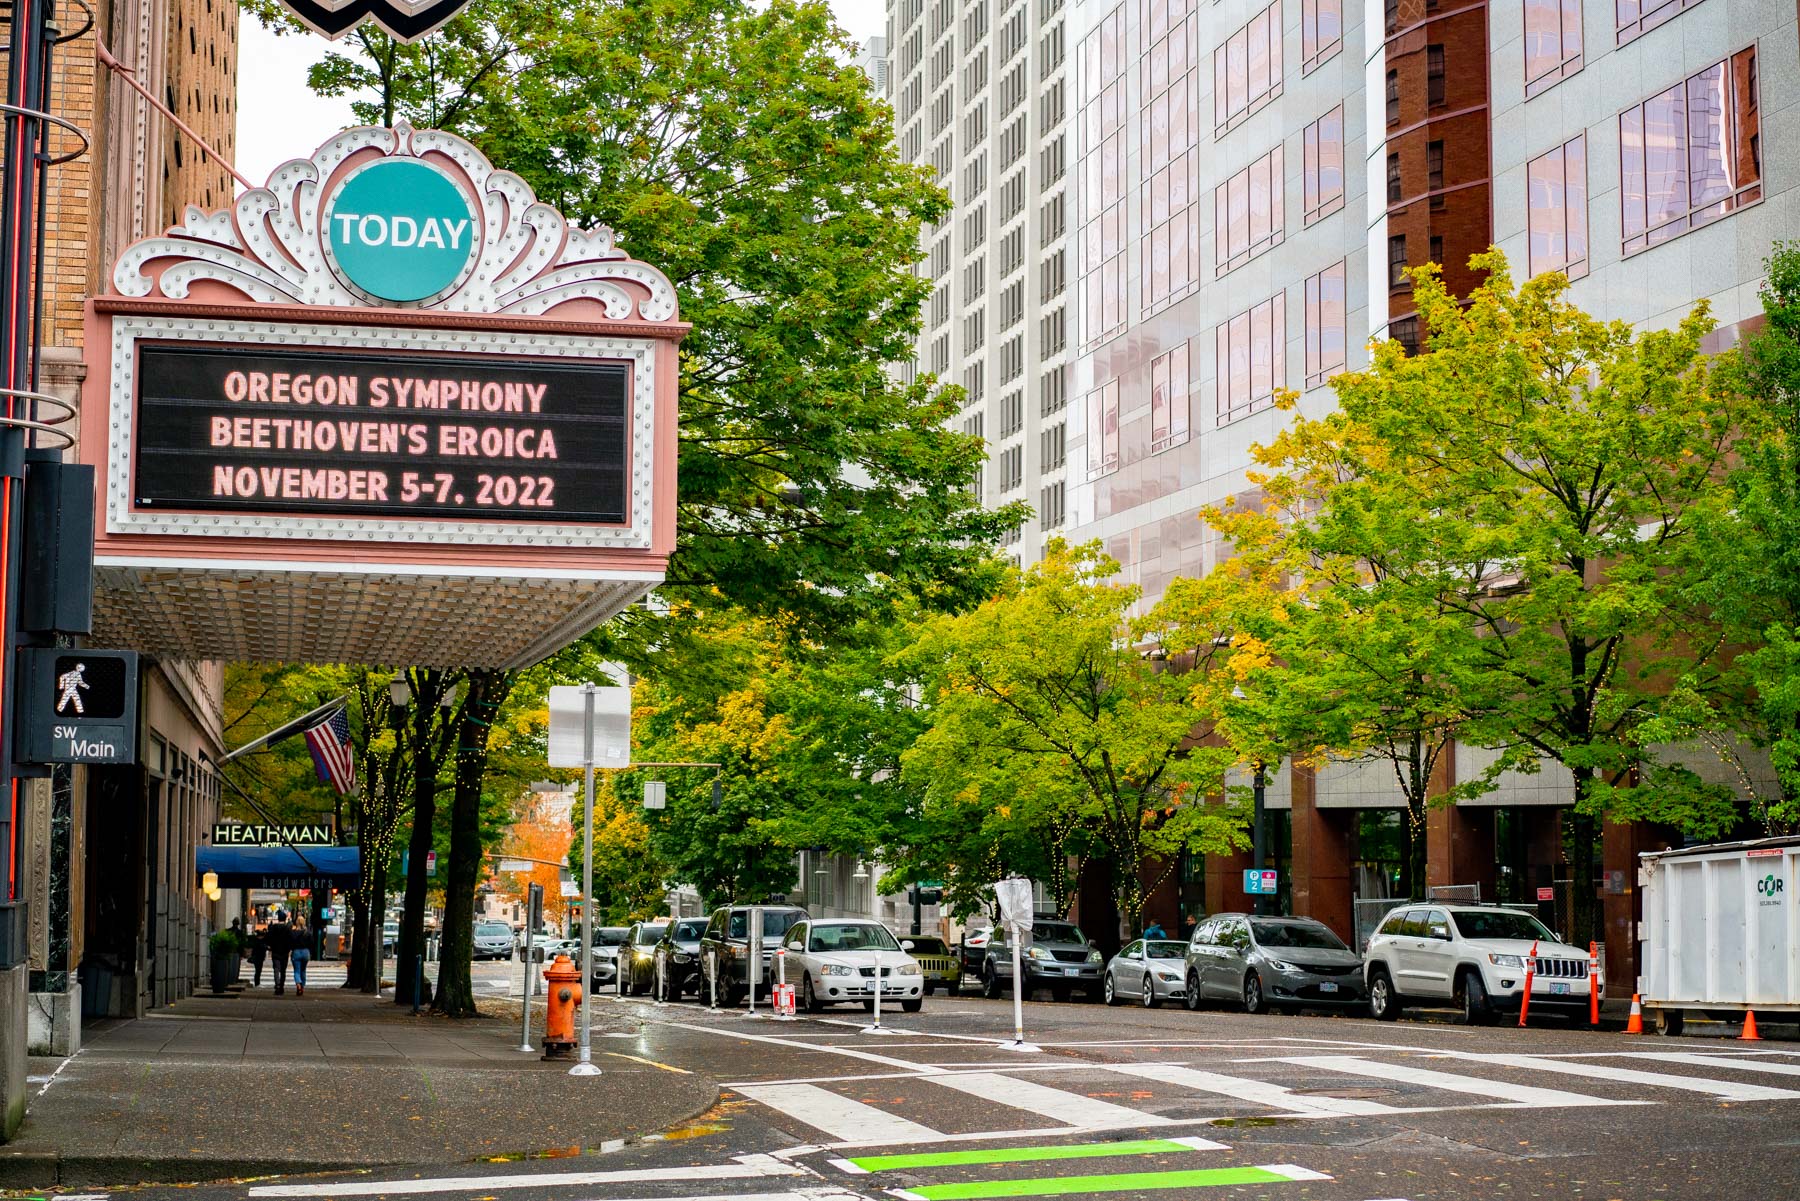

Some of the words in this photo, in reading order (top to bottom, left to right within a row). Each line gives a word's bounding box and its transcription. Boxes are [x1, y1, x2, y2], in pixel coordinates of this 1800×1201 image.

[334, 213, 468, 250] TODAY
[224, 371, 358, 405] OREGON
[369, 377, 547, 412] SYMPHONY
[210, 416, 428, 454] BEETHOVEN'S
[439, 426, 558, 459] EROICA
[213, 466, 389, 501] NOVEMBER
[477, 475, 555, 507] 2022
[54, 725, 78, 739] SW
[70, 739, 115, 758] Main
[215, 825, 329, 842] HEATHMAN
[262, 875, 333, 889] headwaters
[1251, 881, 1257, 890] 2
